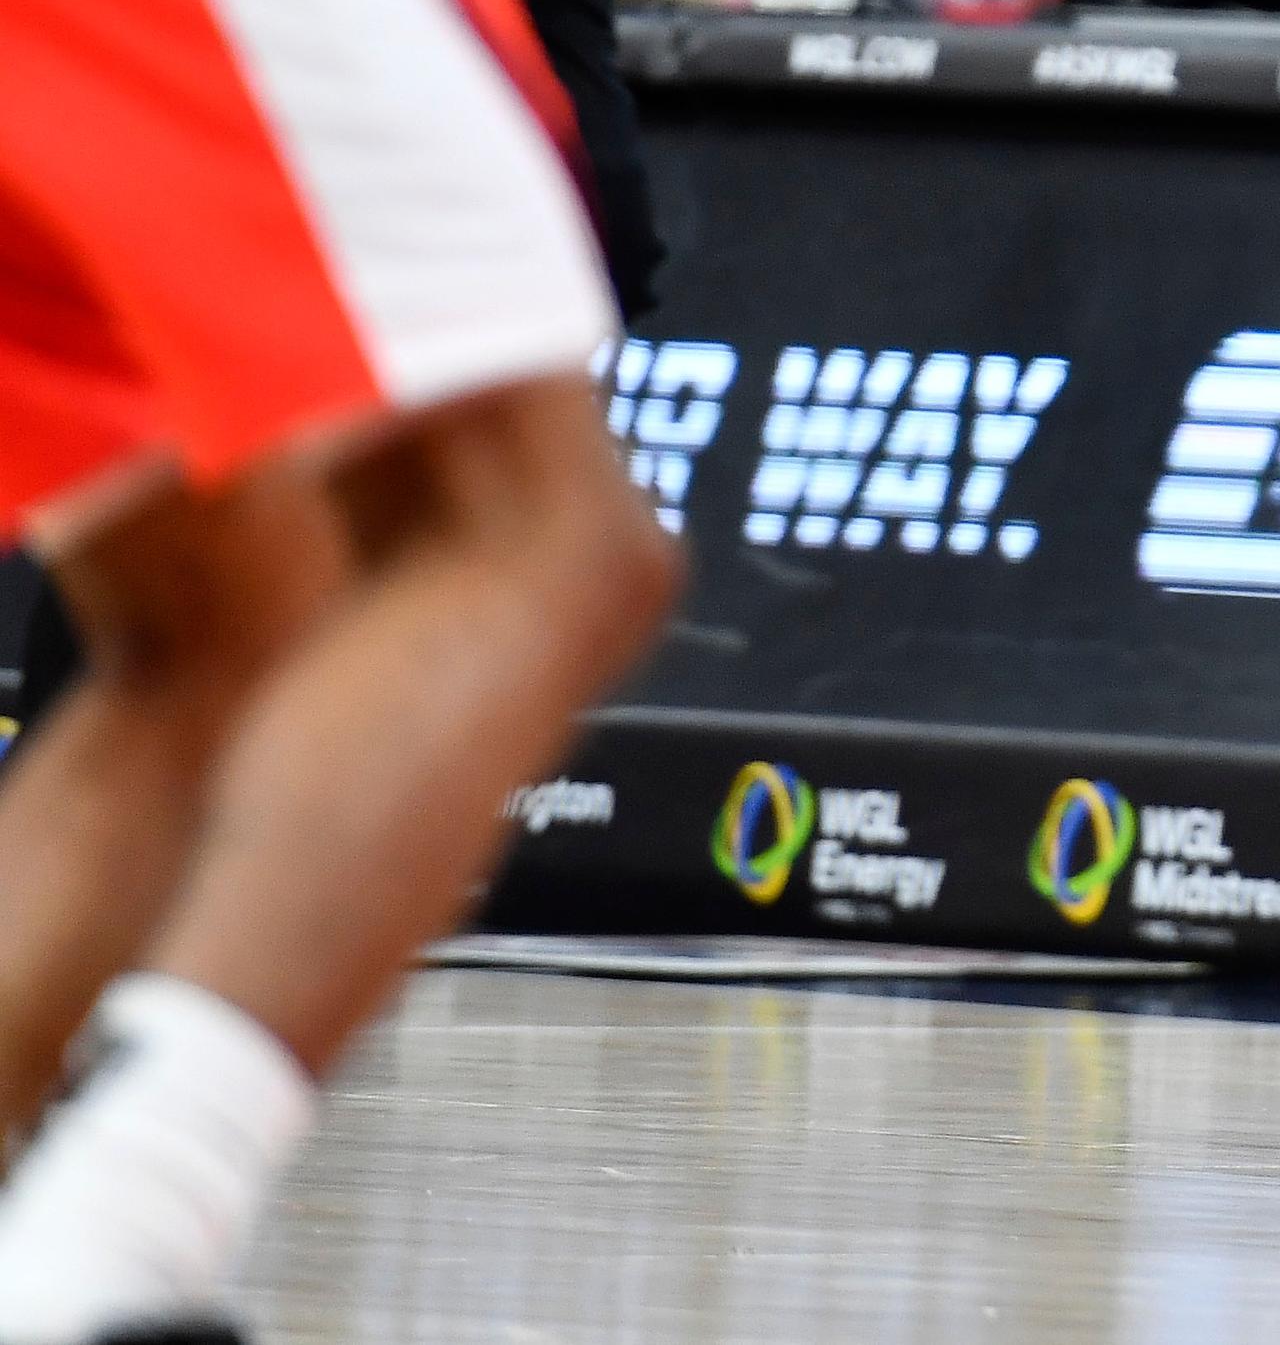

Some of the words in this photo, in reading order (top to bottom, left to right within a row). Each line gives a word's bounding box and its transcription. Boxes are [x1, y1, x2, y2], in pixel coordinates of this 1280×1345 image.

[743, 345, 1069, 560] WAY.
[1140, 804, 1233, 862] WGL
[809, 838, 947, 911] Energy
